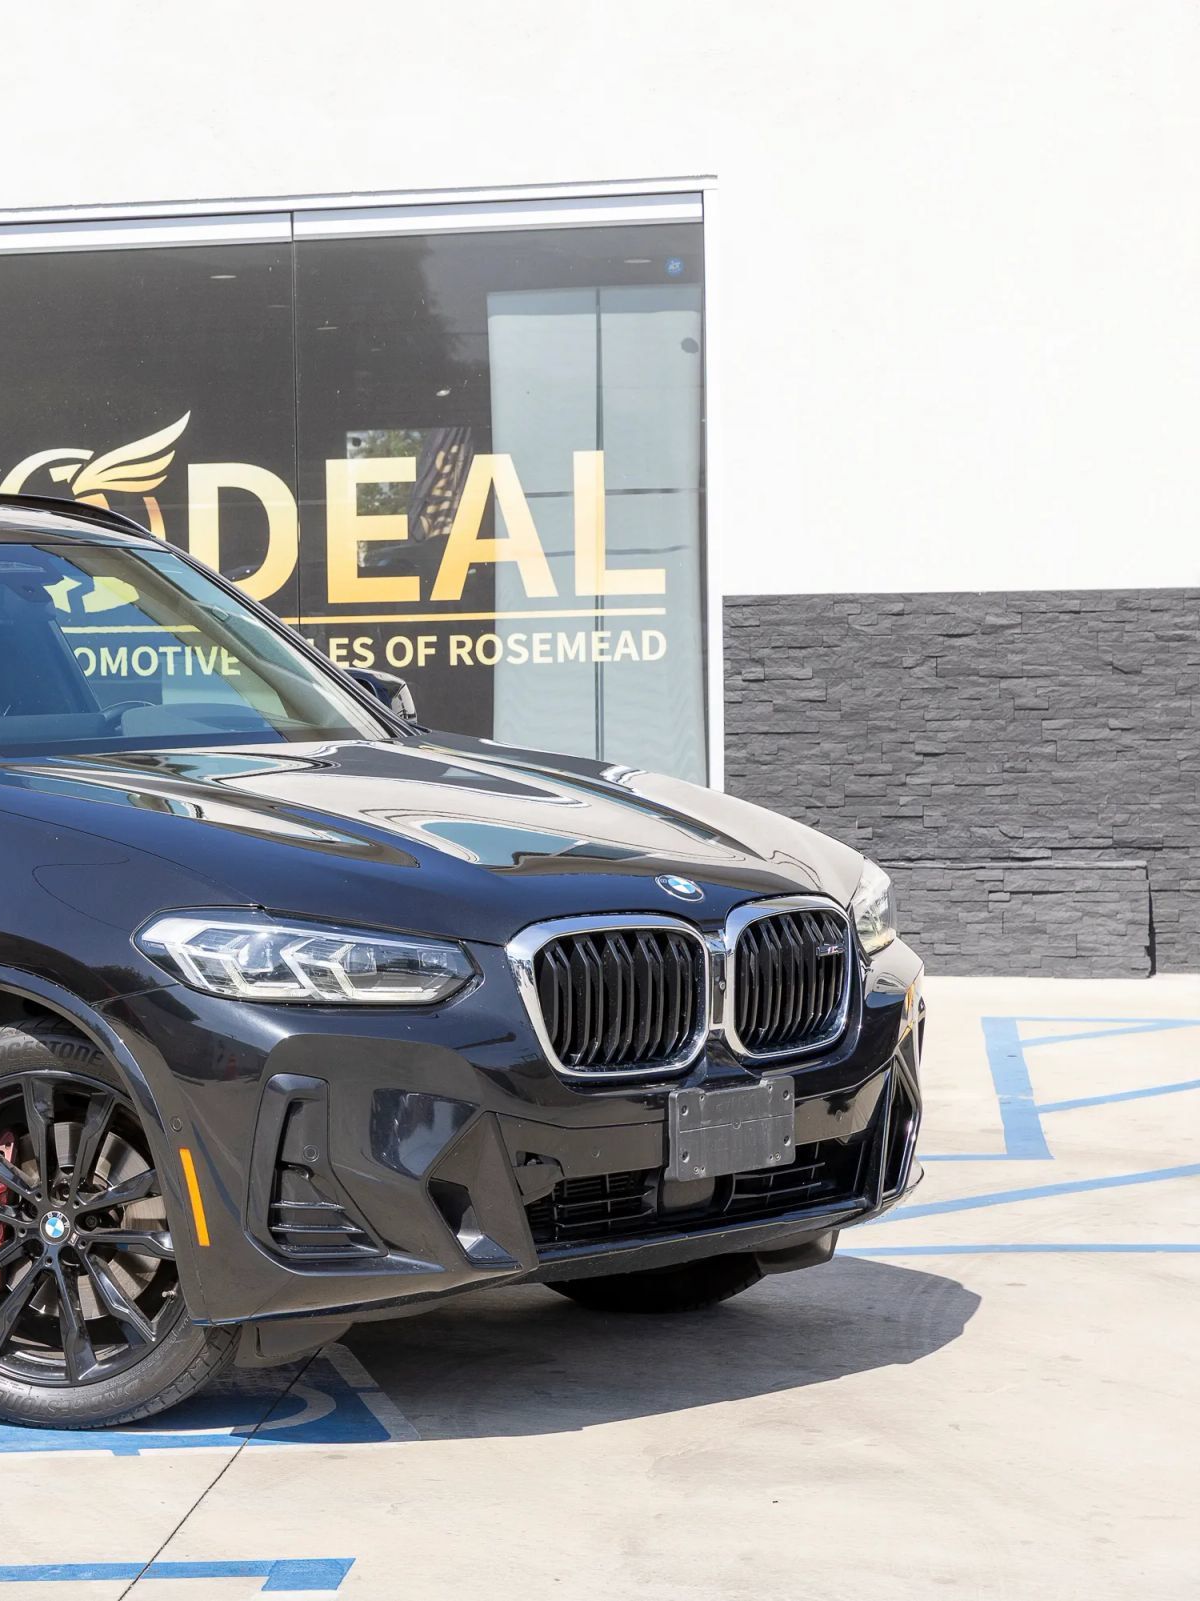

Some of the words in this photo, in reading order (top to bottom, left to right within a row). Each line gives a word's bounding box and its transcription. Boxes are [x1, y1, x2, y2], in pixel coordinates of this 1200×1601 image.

[187, 449, 667, 604] DEAL
[306, 637, 376, 669] ES
[385, 635, 437, 668] OF
[449, 629, 667, 667] ROSEMEAD
